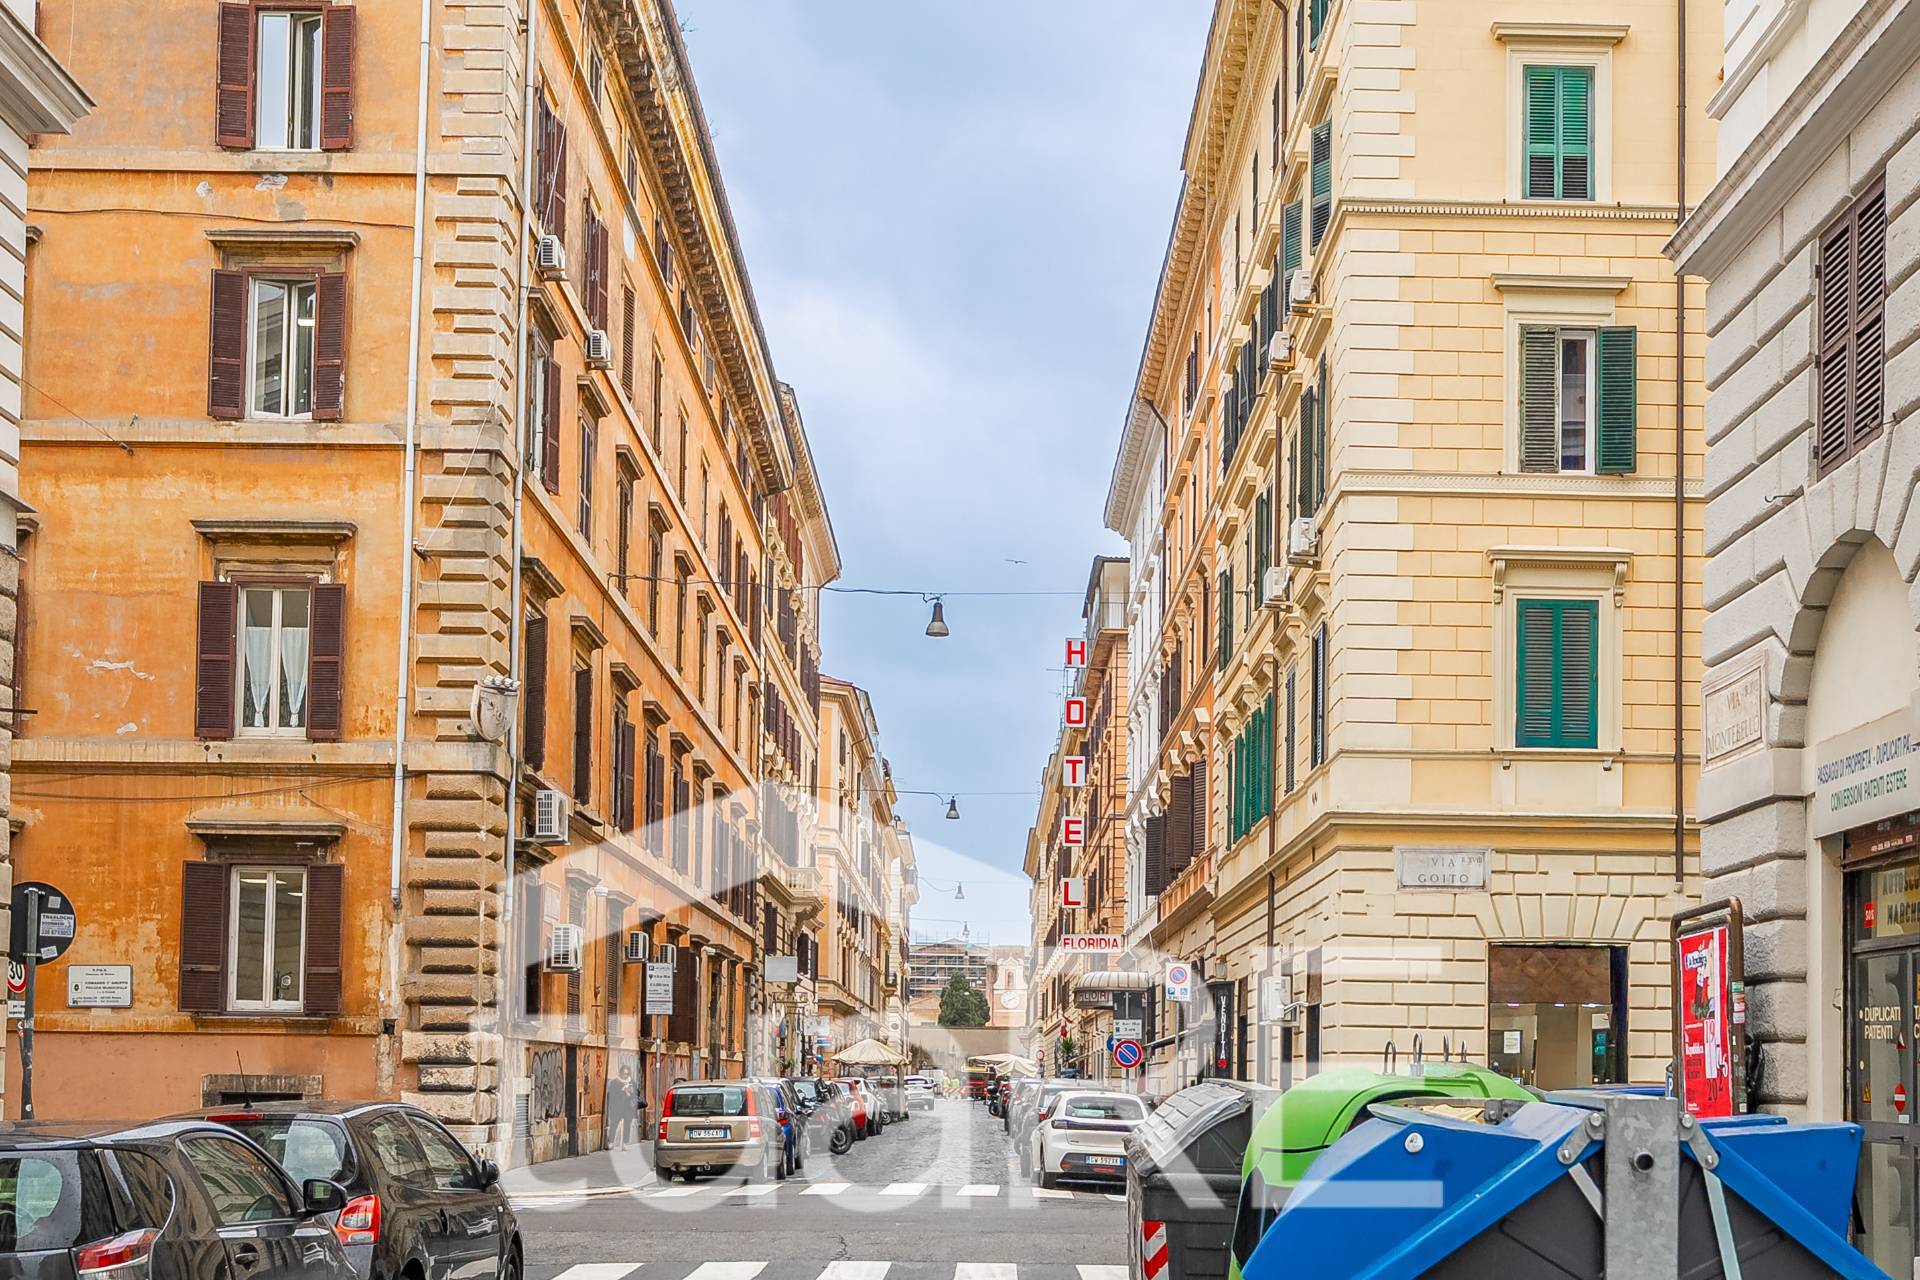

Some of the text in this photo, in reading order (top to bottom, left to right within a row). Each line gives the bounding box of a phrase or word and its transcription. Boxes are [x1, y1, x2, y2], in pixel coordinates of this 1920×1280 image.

[1726, 690, 1741, 711] VIA
[1707, 715, 1760, 754] MONTEBELLO
[1063, 640, 1085, 906] HOTEL
[1864, 776, 1885, 800] PATENTI
[1886, 767, 1907, 793] ESTERE
[1431, 857, 1455, 867] VIA
[1417, 873, 1469, 884] GOITO
[1865, 909, 1875, 920] SOS
[1063, 937, 1119, 950] FLORIDIA
[8, 959, 23, 980] 30
[1864, 1006, 1901, 1022] DUPLICATI
[1864, 1024, 1893, 1040] PATENTI
